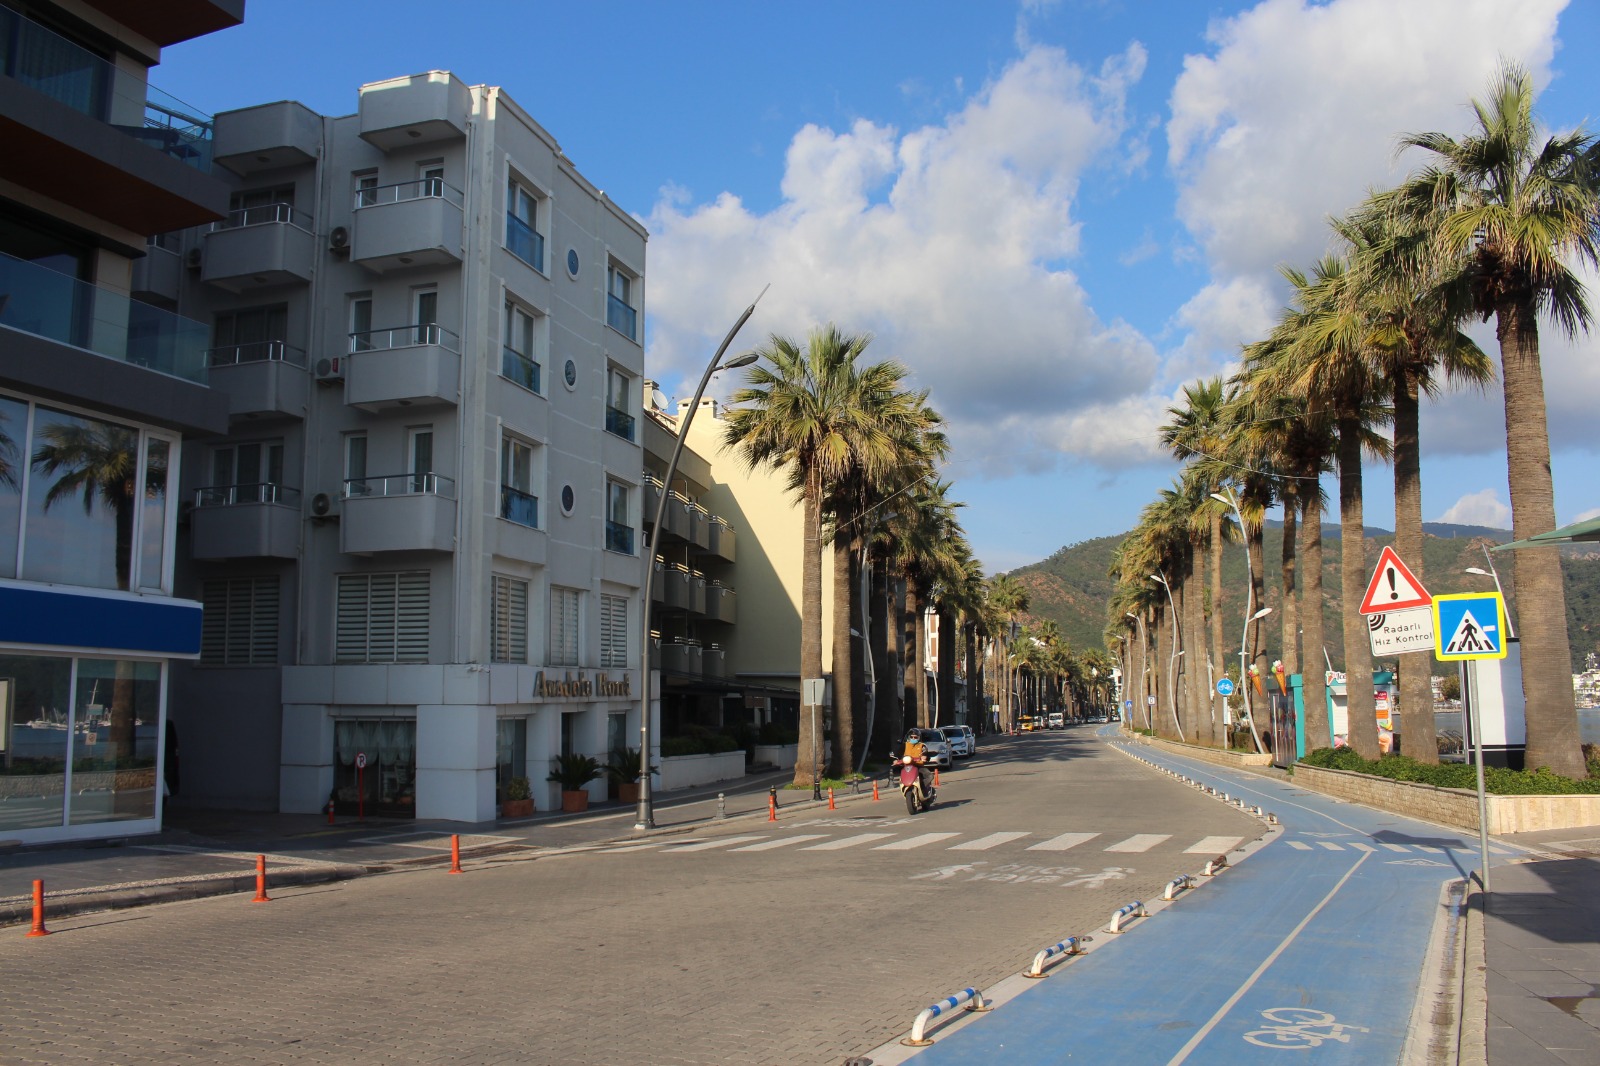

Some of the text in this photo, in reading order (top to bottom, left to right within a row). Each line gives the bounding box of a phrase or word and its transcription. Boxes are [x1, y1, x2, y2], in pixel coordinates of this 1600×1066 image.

[1383, 623, 1421, 634] Radarlı
[1375, 632, 1433, 646] Hız Kontrol
